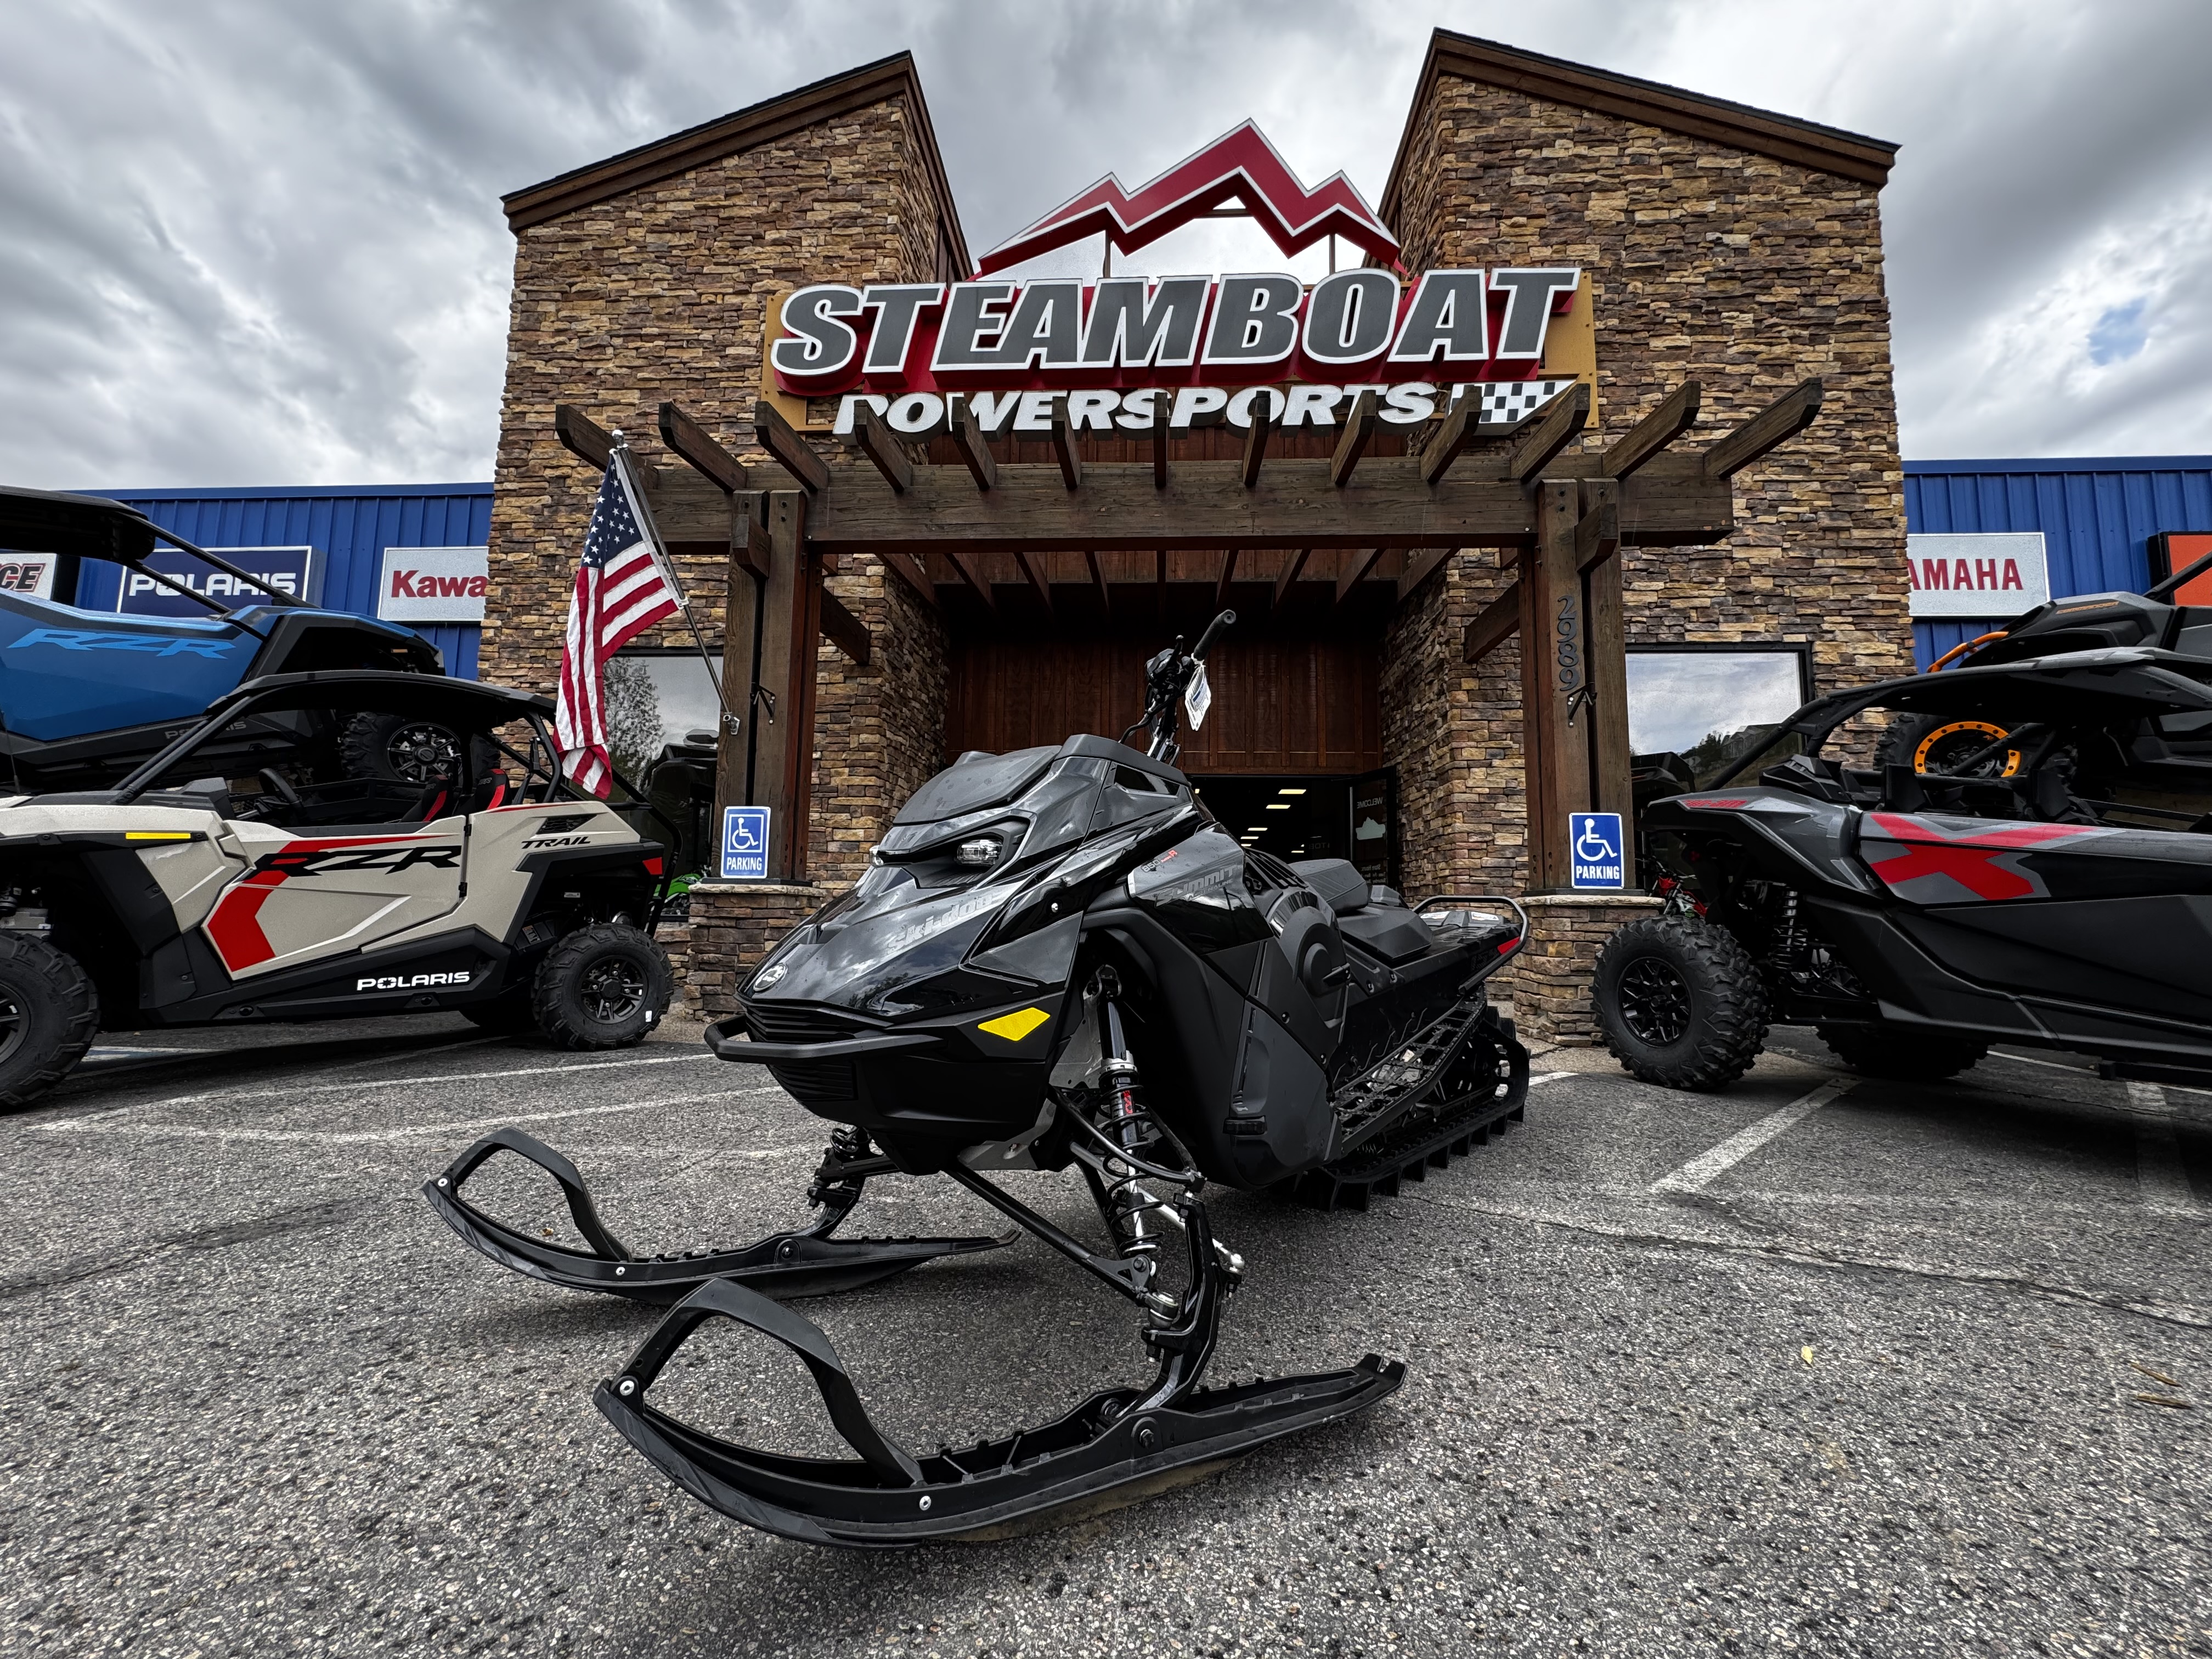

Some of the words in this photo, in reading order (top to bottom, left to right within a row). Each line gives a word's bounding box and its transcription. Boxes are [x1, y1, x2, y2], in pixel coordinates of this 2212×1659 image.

[770, 268, 1581, 377] STEAMBOAT
[832, 382, 1437, 435] POWERSPORTS
[128, 572, 296, 596] POLARIS
[391, 570, 488, 598] Kawa
[7, 628, 236, 659] RZR
[1557, 594, 1581, 692] 2989
[521, 836, 591, 850] TRAIL
[241, 845, 462, 882] RZR
[726, 857, 763, 871] PARKING
[1142, 859, 1160, 872] 850
[1576, 865, 1620, 880] PARKING
[1155, 865, 1238, 907] SUMMIT
[357, 971, 470, 991] POLARIS
